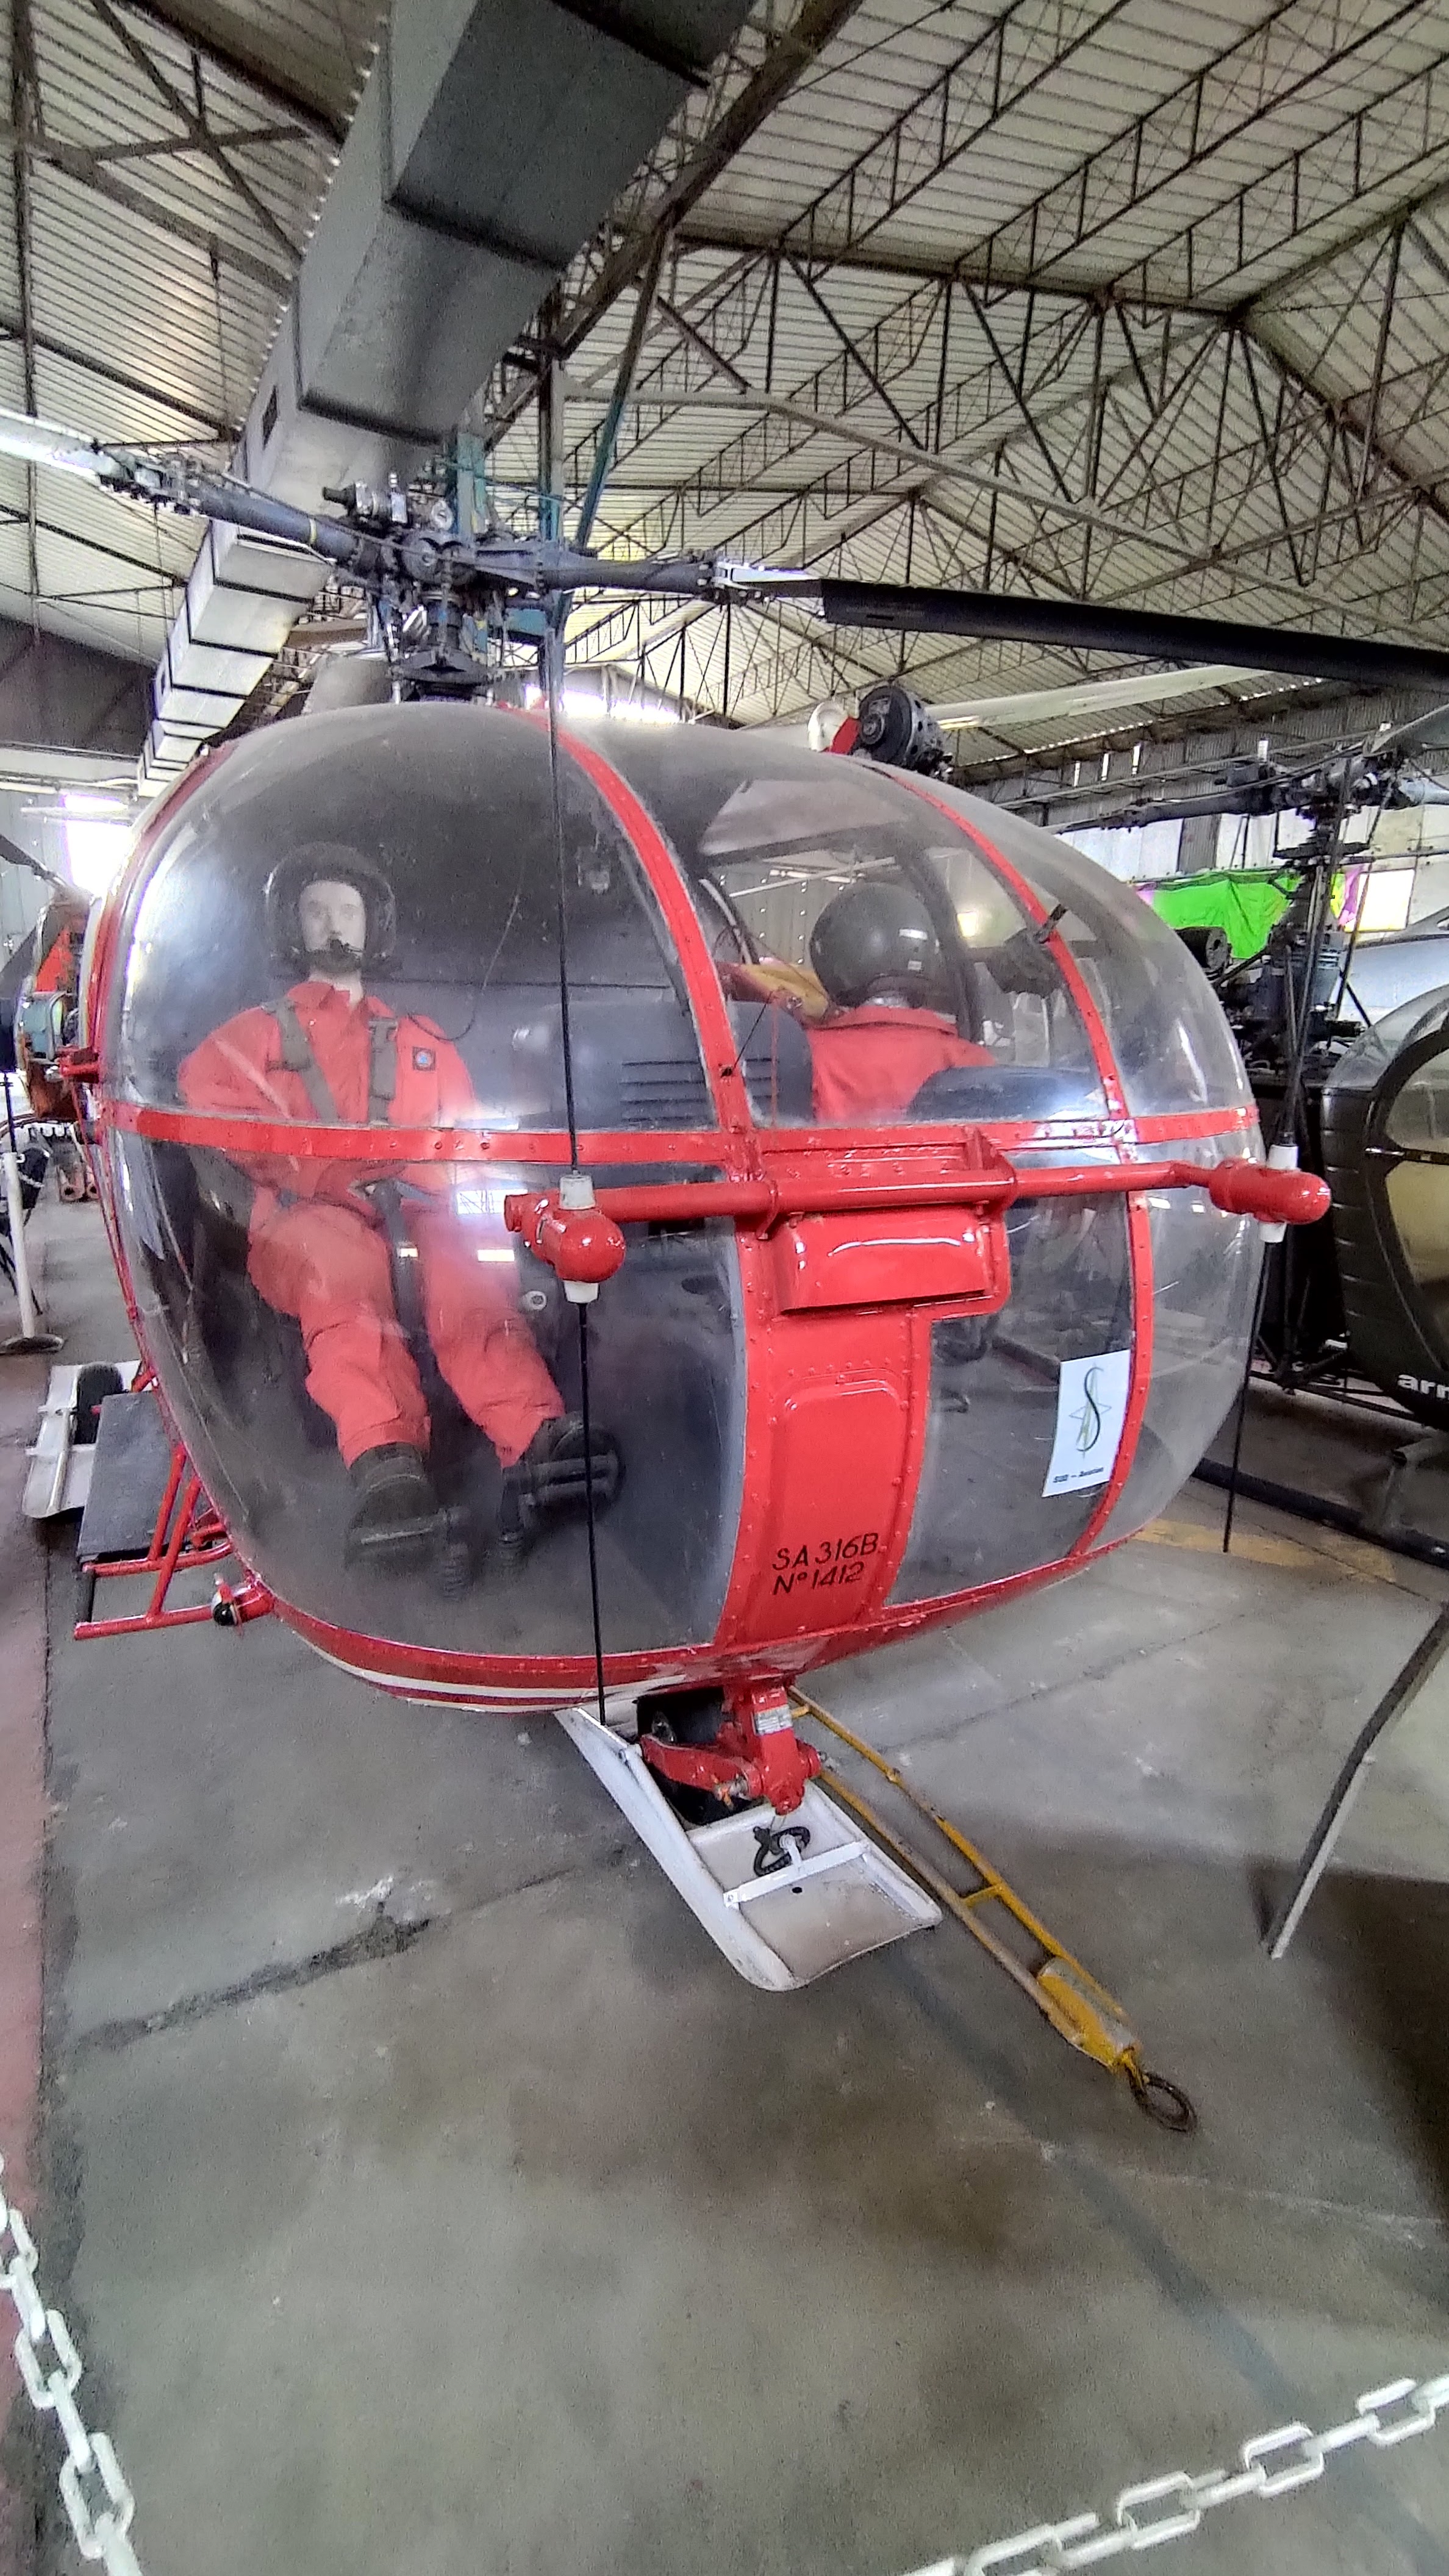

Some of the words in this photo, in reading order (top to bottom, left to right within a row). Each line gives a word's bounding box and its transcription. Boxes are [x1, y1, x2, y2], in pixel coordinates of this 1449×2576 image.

[772, 1545, 809, 1571] SA
[815, 1533, 879, 1564] 316B
[812, 1561, 865, 1590] 1412
